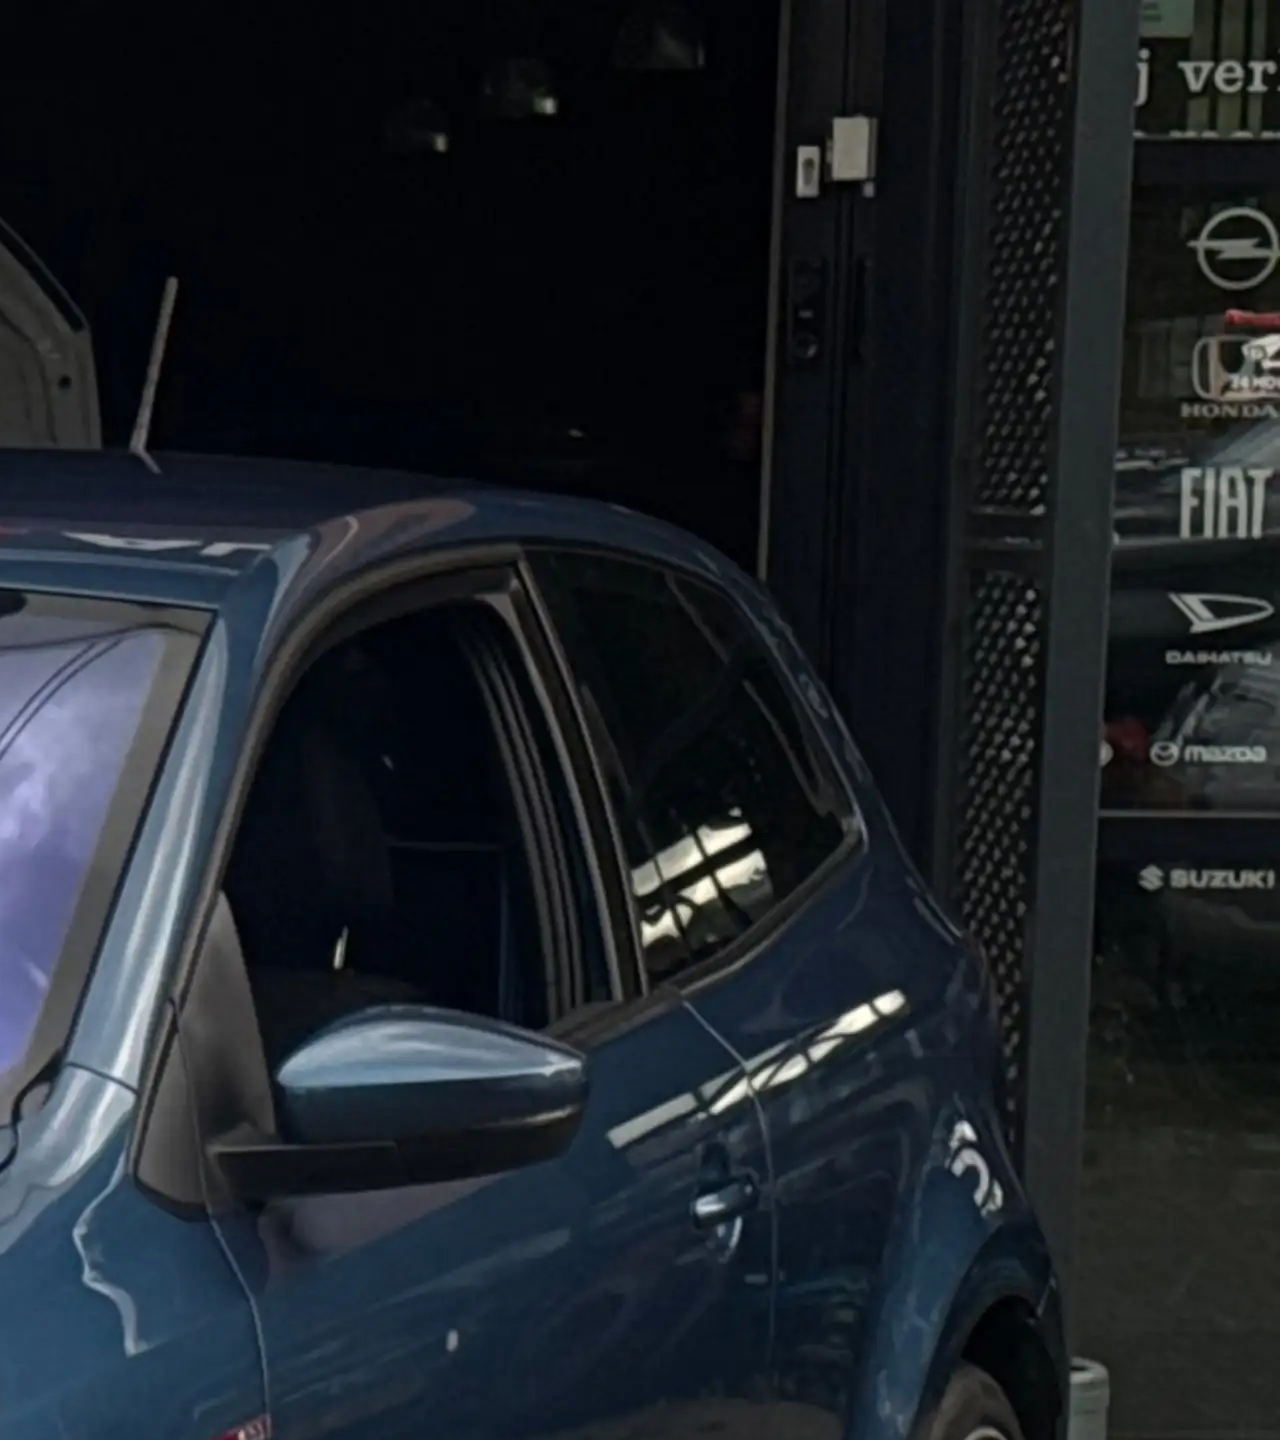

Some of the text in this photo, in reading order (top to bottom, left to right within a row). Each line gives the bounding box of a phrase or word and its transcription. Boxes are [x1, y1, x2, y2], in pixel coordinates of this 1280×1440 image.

[1177, 47, 1280, 94] ver
[1180, 401, 1279, 419] HONDA
[1179, 465, 1275, 540] FIAT
[1164, 650, 1273, 666] DAIHATSU
[1169, 867, 1277, 890] SUZUKI
